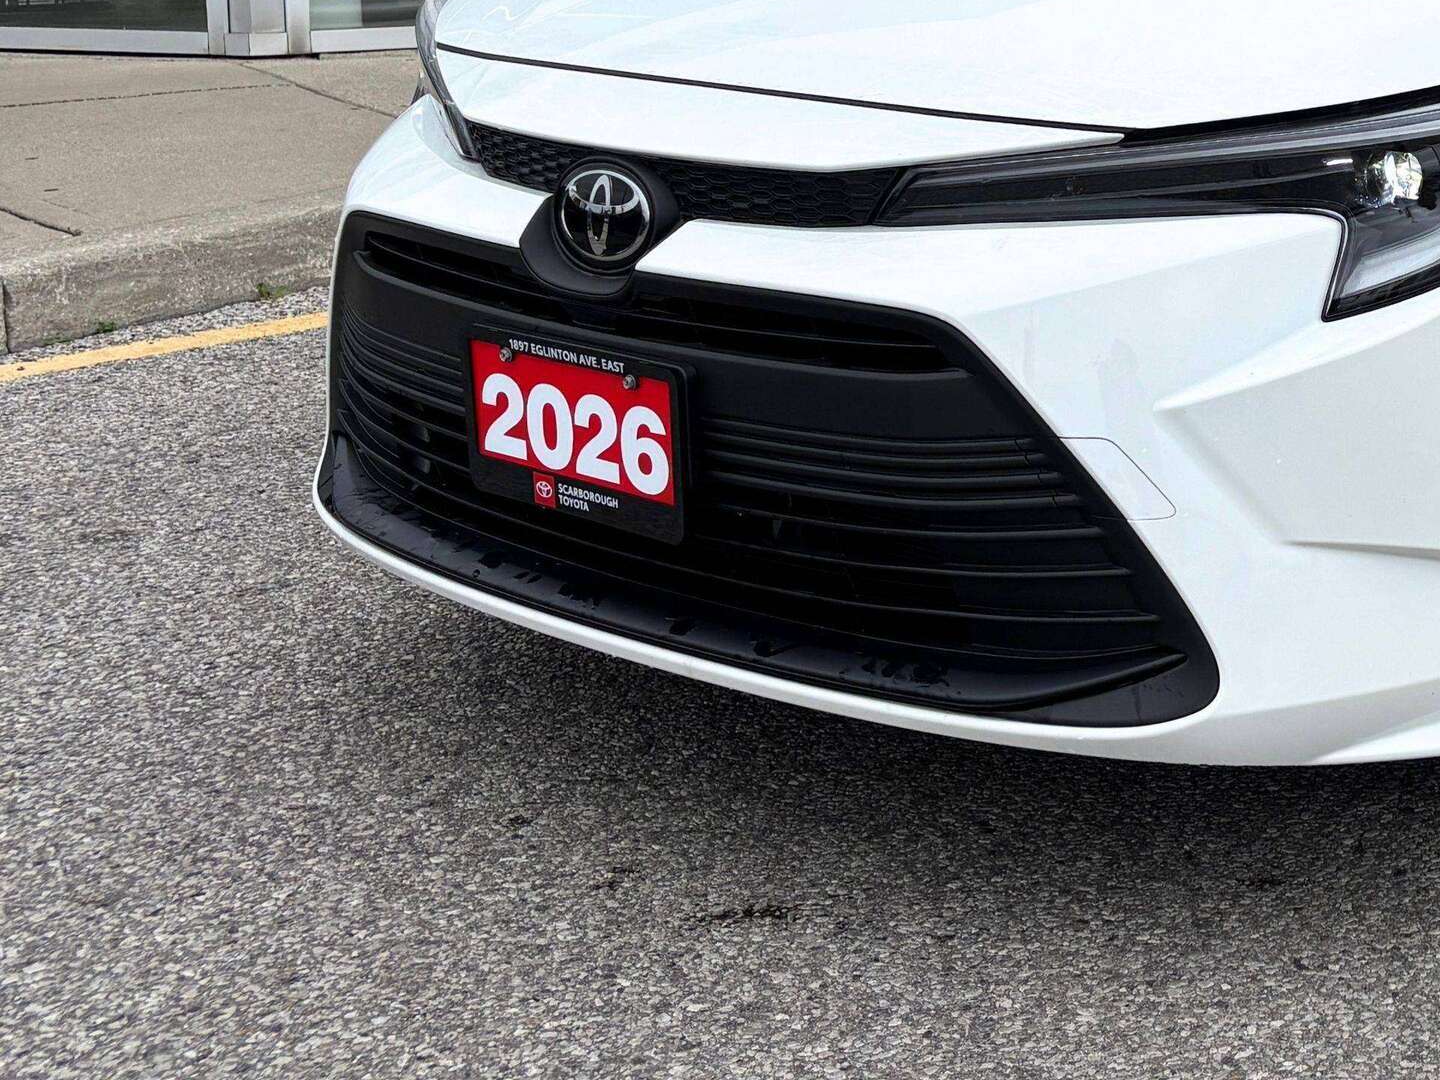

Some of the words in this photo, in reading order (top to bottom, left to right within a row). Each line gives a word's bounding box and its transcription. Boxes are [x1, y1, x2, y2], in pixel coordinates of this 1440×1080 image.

[508, 338, 529, 353] 1897
[530, 343, 577, 364] EGLINTON
[578, 352, 601, 369] AVE.
[601, 358, 625, 374] EAST
[482, 372, 670, 496] 2026
[557, 482, 619, 509] SCARBOROUGH
[558, 495, 590, 512] TOYOTA
